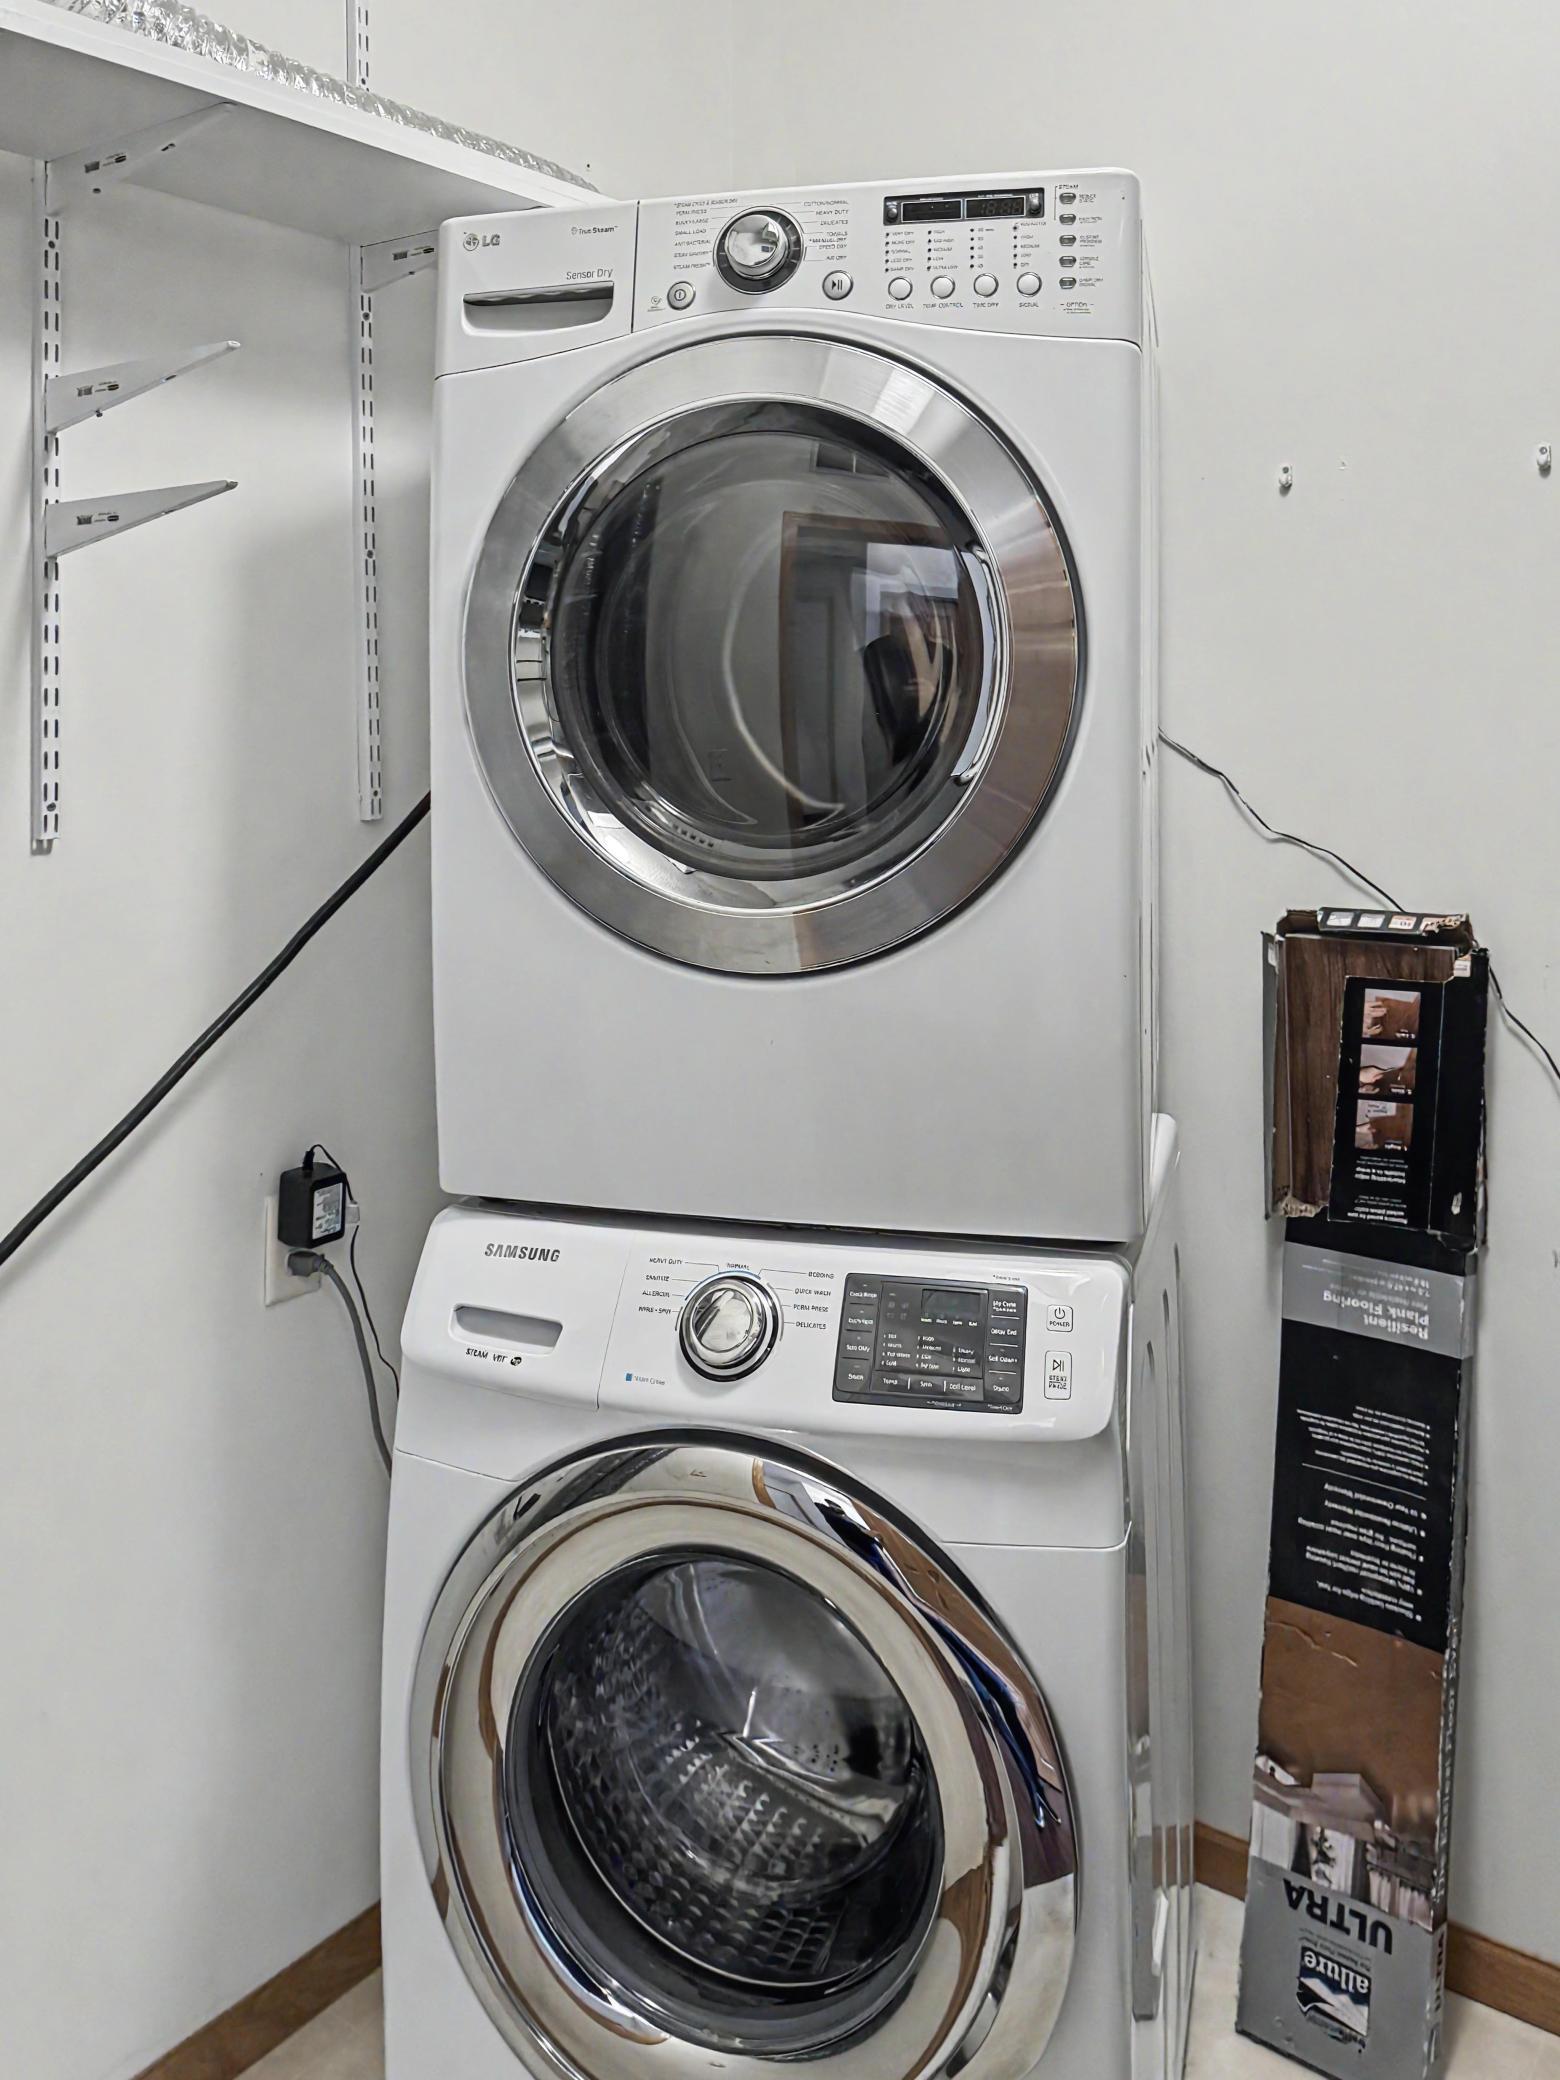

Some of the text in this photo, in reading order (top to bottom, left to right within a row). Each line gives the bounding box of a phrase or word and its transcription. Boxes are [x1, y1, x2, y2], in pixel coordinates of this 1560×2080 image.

[482, 233, 500, 247] LG
[566, 268, 614, 280] Sensor Dry
[484, 1242, 560, 1262] SAMSUNG
[1323, 1289, 1430, 1326] Plank Flooring
[795, 1321, 827, 1330] DELICATES
[1363, 1313, 1428, 1340] Resilient
[465, 1347, 488, 1359] STEAM
[1282, 1877, 1393, 1956] ULTRA
[1303, 1950, 1370, 1994] allure
